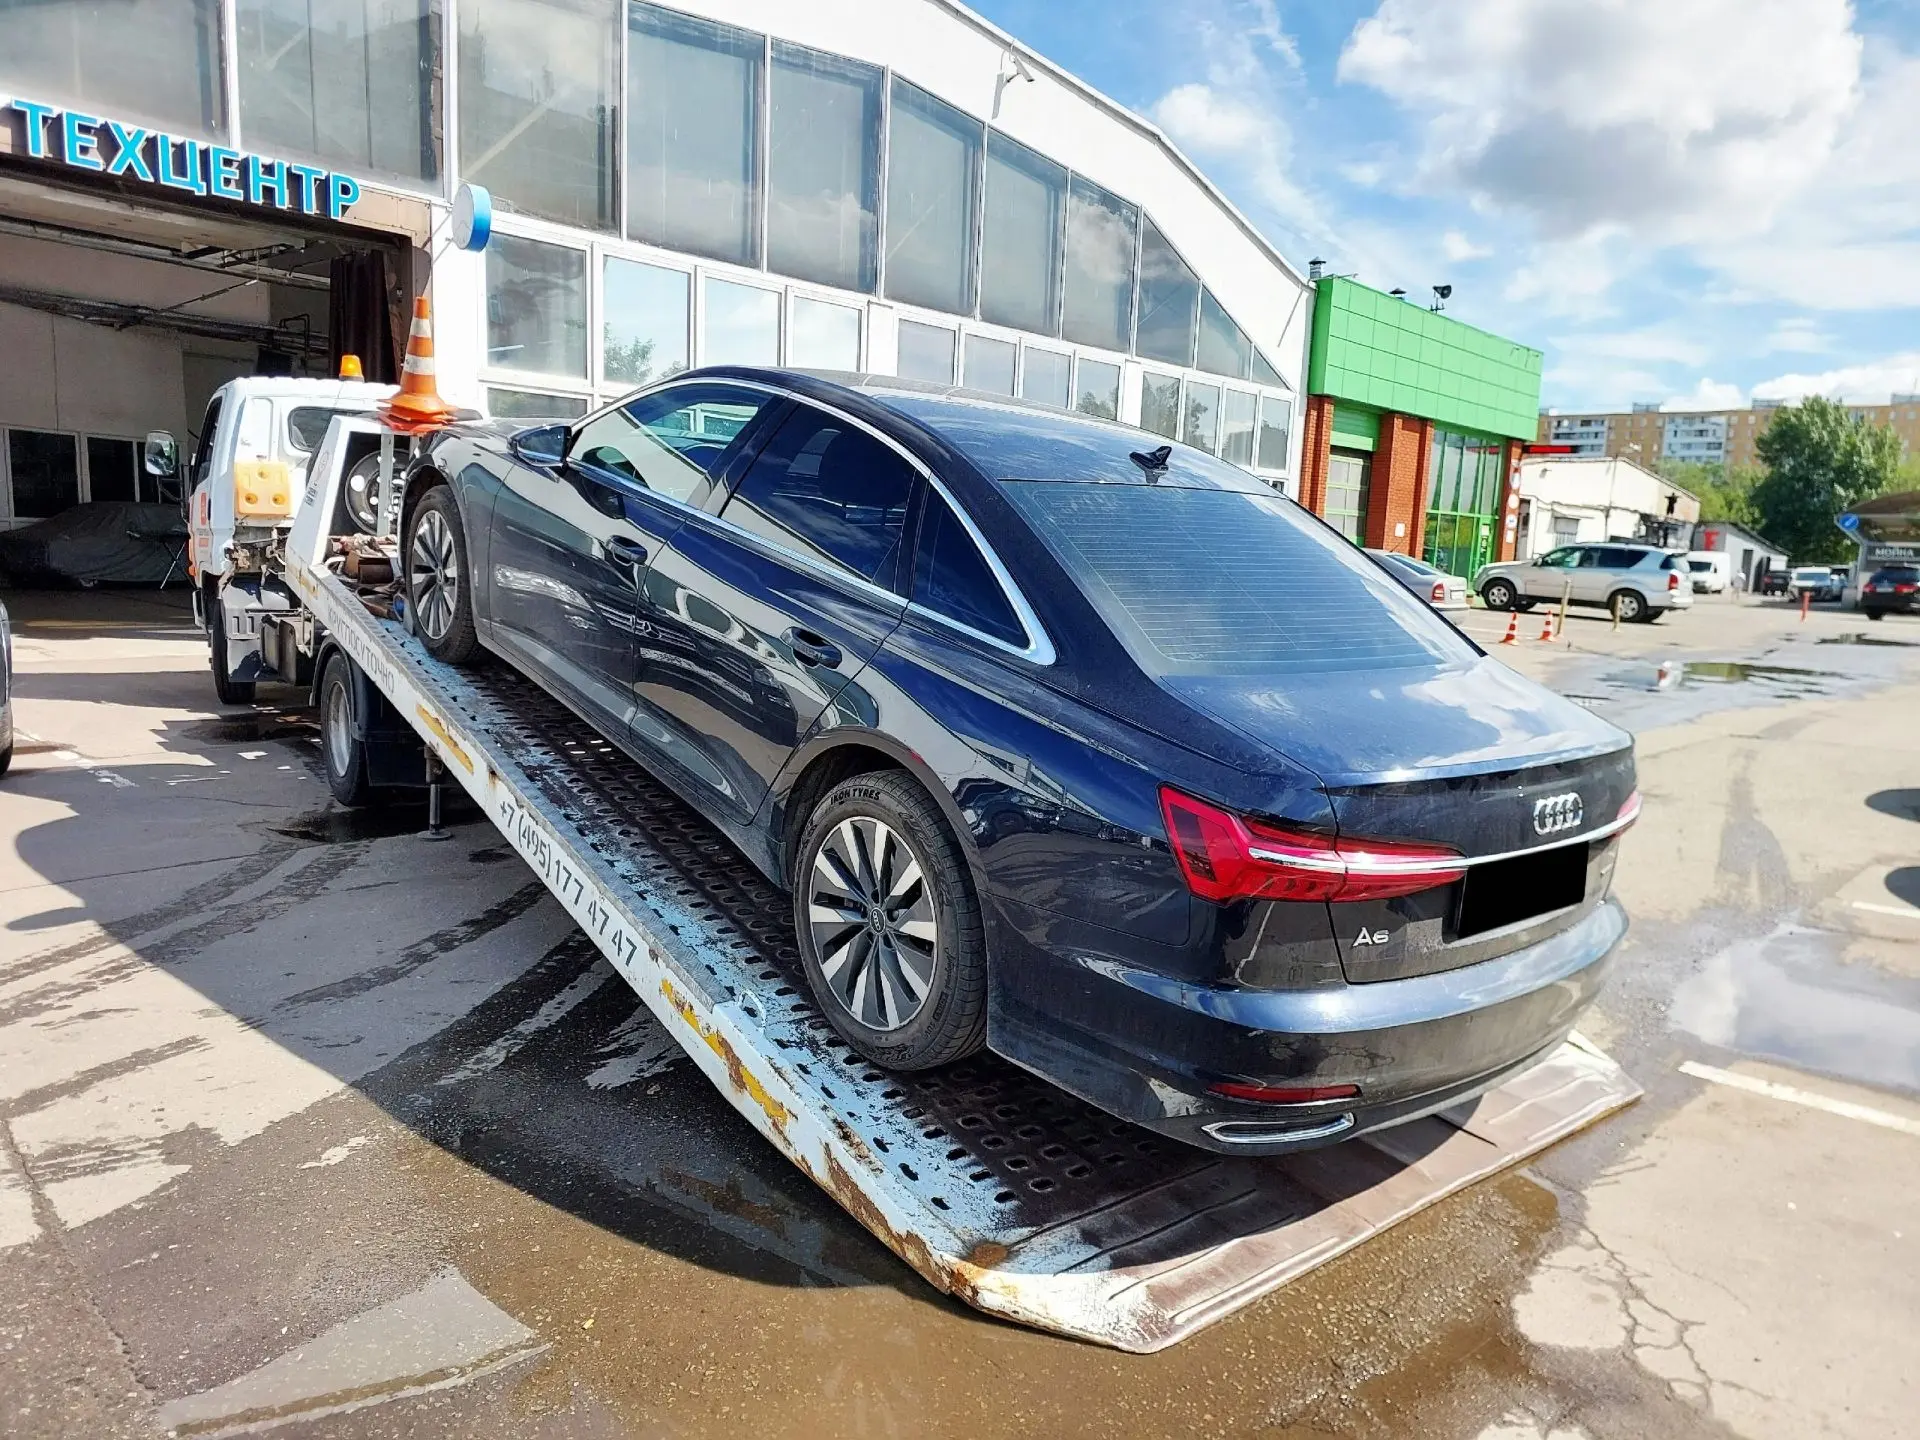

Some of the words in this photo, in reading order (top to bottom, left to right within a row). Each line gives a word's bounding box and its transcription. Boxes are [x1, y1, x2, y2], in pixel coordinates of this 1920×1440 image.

[10, 97, 361, 220] ТЕХЦЕНТР
[852, 788, 881, 801] TYRES
[499, 800, 516, 829] +7
[518, 813, 551, 877] (495)
[555, 859, 584, 906] 177
[587, 899, 610, 936] 47
[611, 929, 638, 967] 47
[1352, 926, 1390, 948] A6
